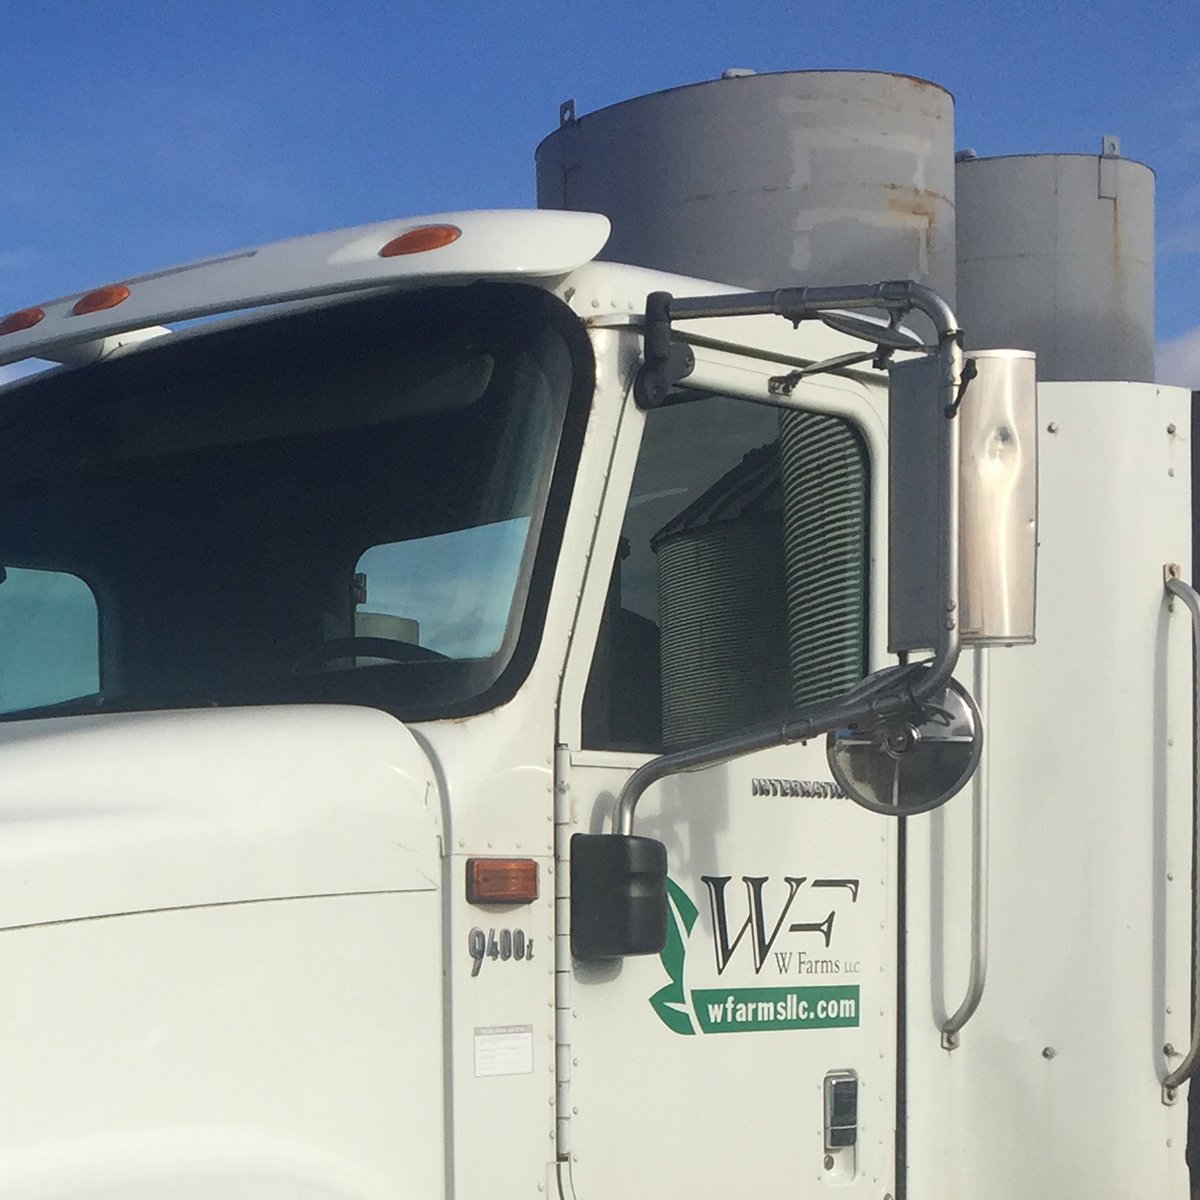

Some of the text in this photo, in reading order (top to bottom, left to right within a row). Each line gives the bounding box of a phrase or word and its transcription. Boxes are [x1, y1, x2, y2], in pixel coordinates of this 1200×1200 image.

[751, 778, 850, 800] INTERNATIO
[468, 927, 535, 977] 9400i
[774, 951, 861, 975] W Farms LLC
[707, 993, 856, 1024] wfarmsllc.com
